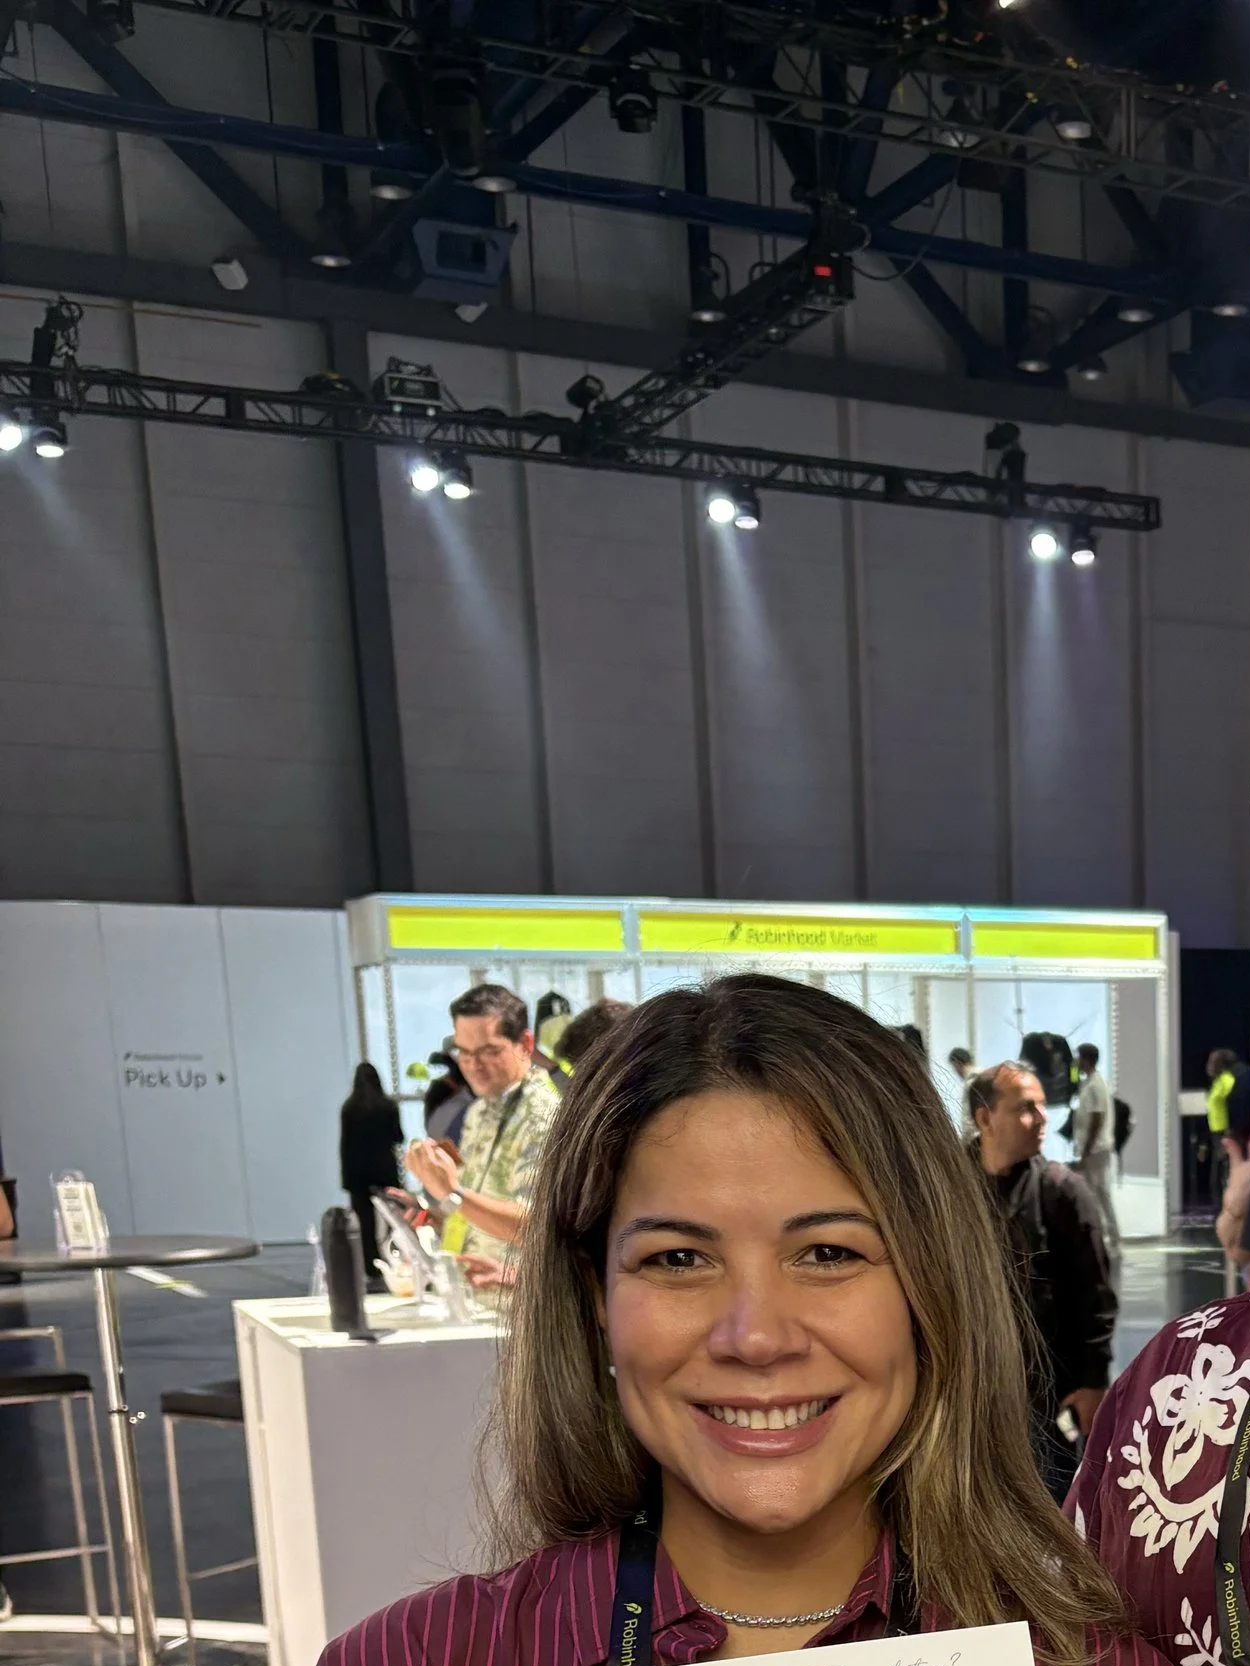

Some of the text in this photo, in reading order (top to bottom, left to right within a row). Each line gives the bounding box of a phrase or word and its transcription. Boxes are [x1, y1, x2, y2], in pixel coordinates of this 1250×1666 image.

[125, 1066, 208, 1091] Pick Up
[1223, 1577, 1246, 1660] Robinhood
